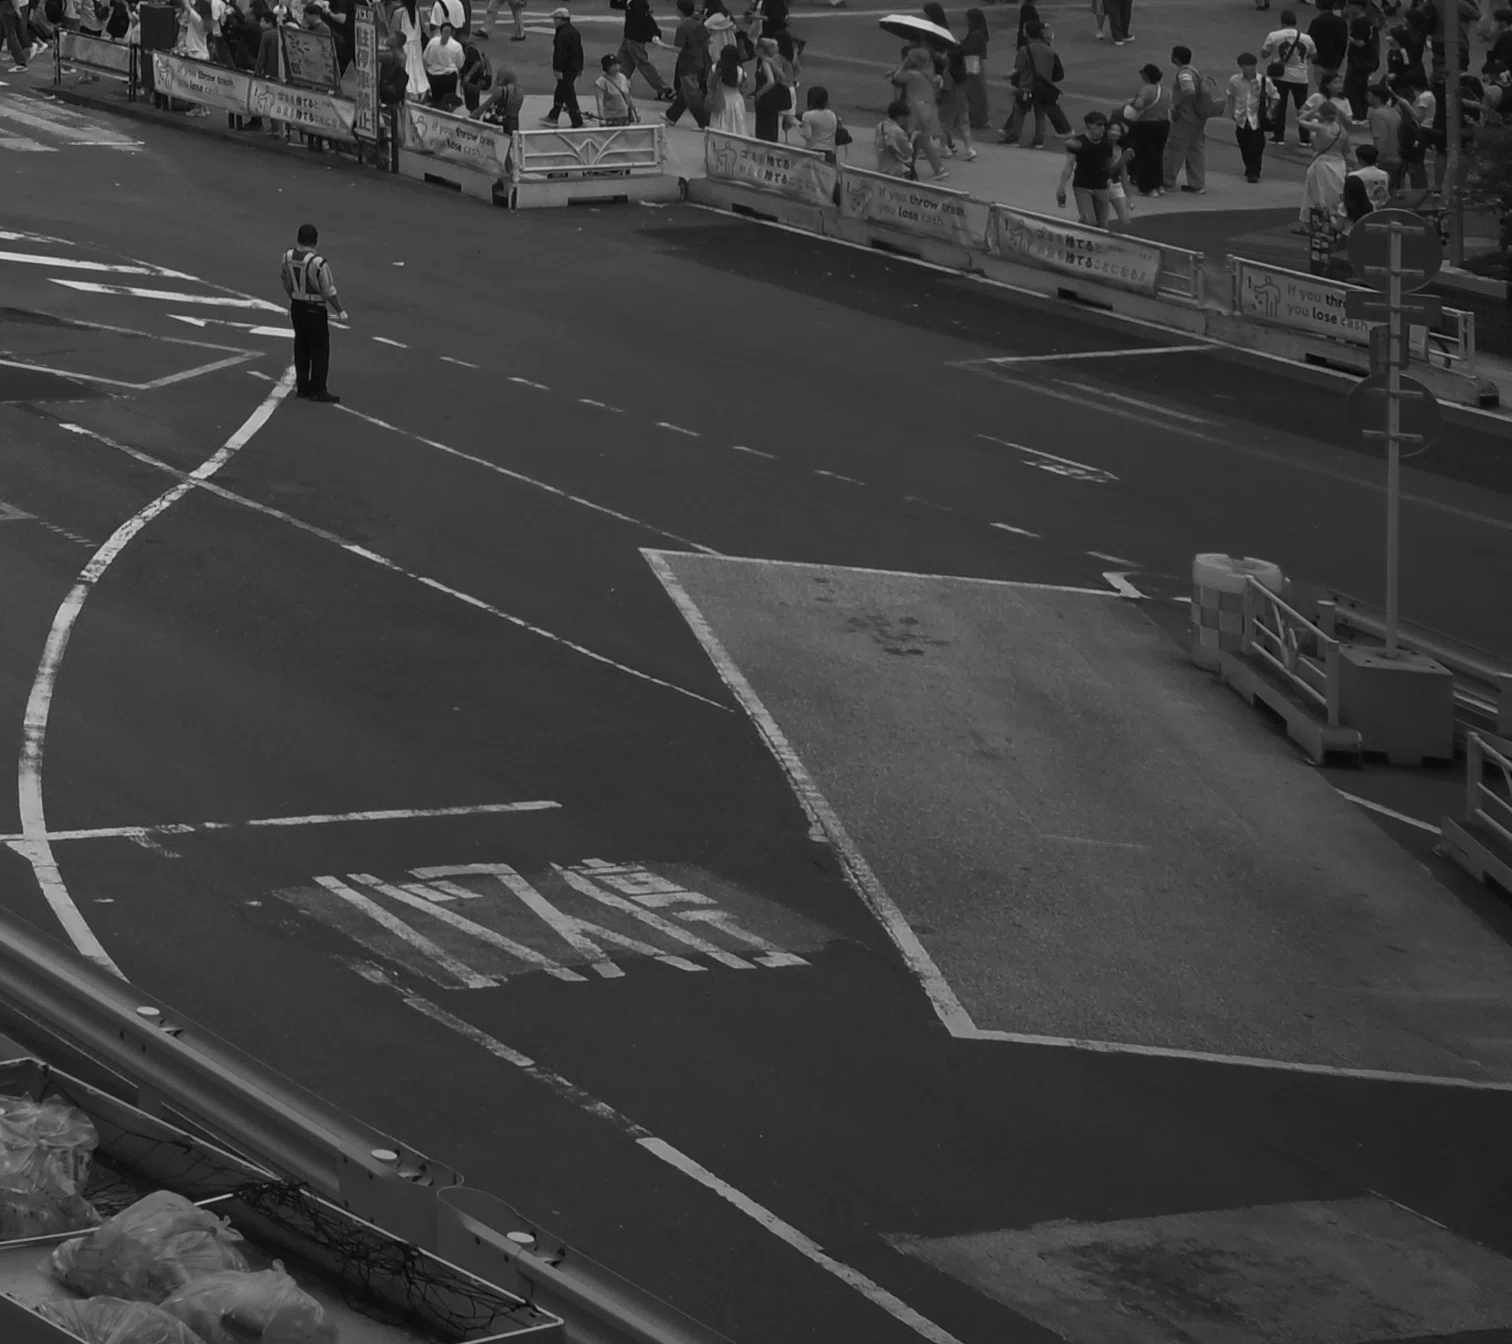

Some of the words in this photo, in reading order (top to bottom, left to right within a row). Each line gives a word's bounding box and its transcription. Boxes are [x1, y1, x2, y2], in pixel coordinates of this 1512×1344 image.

[909, 192, 938, 211] throw
[897, 203, 919, 221] lose
[1299, 287, 1321, 304] you
[1287, 302, 1311, 318] you
[1312, 306, 1338, 326] lose
